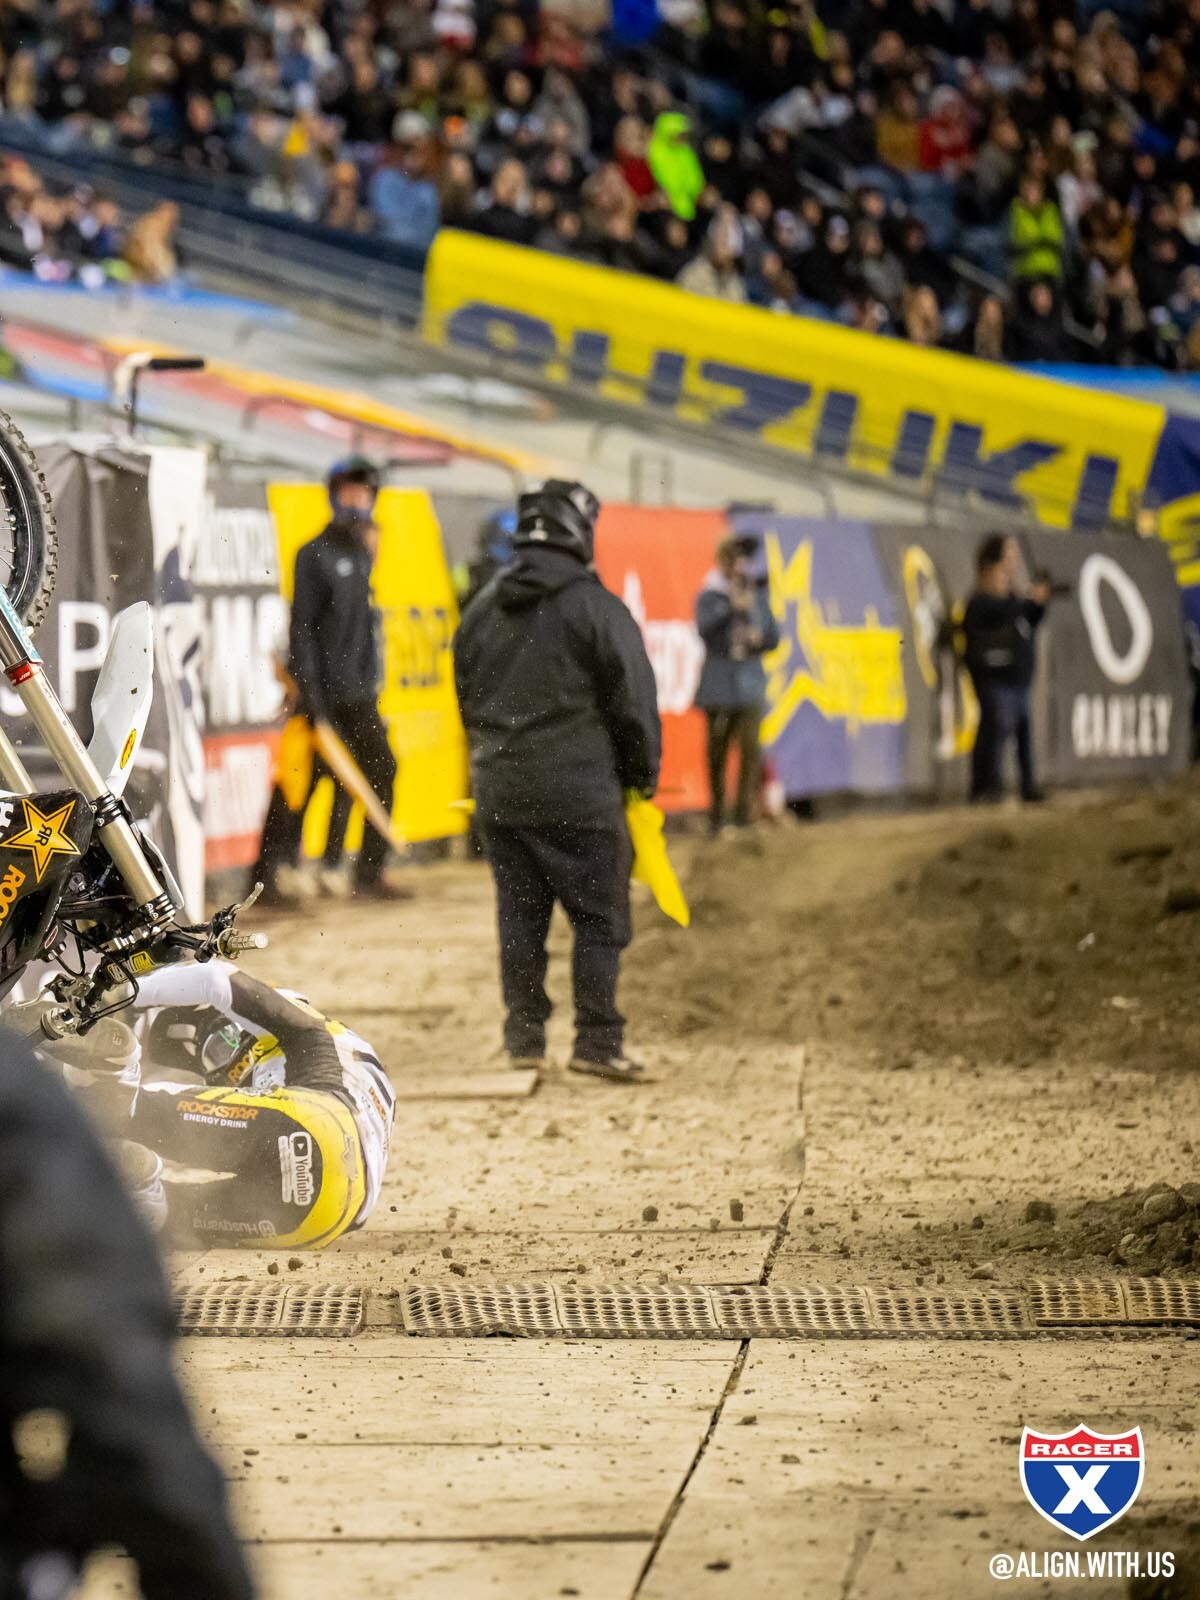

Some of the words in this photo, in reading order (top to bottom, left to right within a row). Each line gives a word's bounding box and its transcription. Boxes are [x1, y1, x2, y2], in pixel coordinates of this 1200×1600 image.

[1072, 693, 1173, 757] OAKLEY
[176, 1099, 260, 1121] ROCKSTAR
[183, 1113, 220, 1126] ENERGY
[220, 1117, 248, 1129] DRINK
[293, 1159, 308, 1203] YouTube
